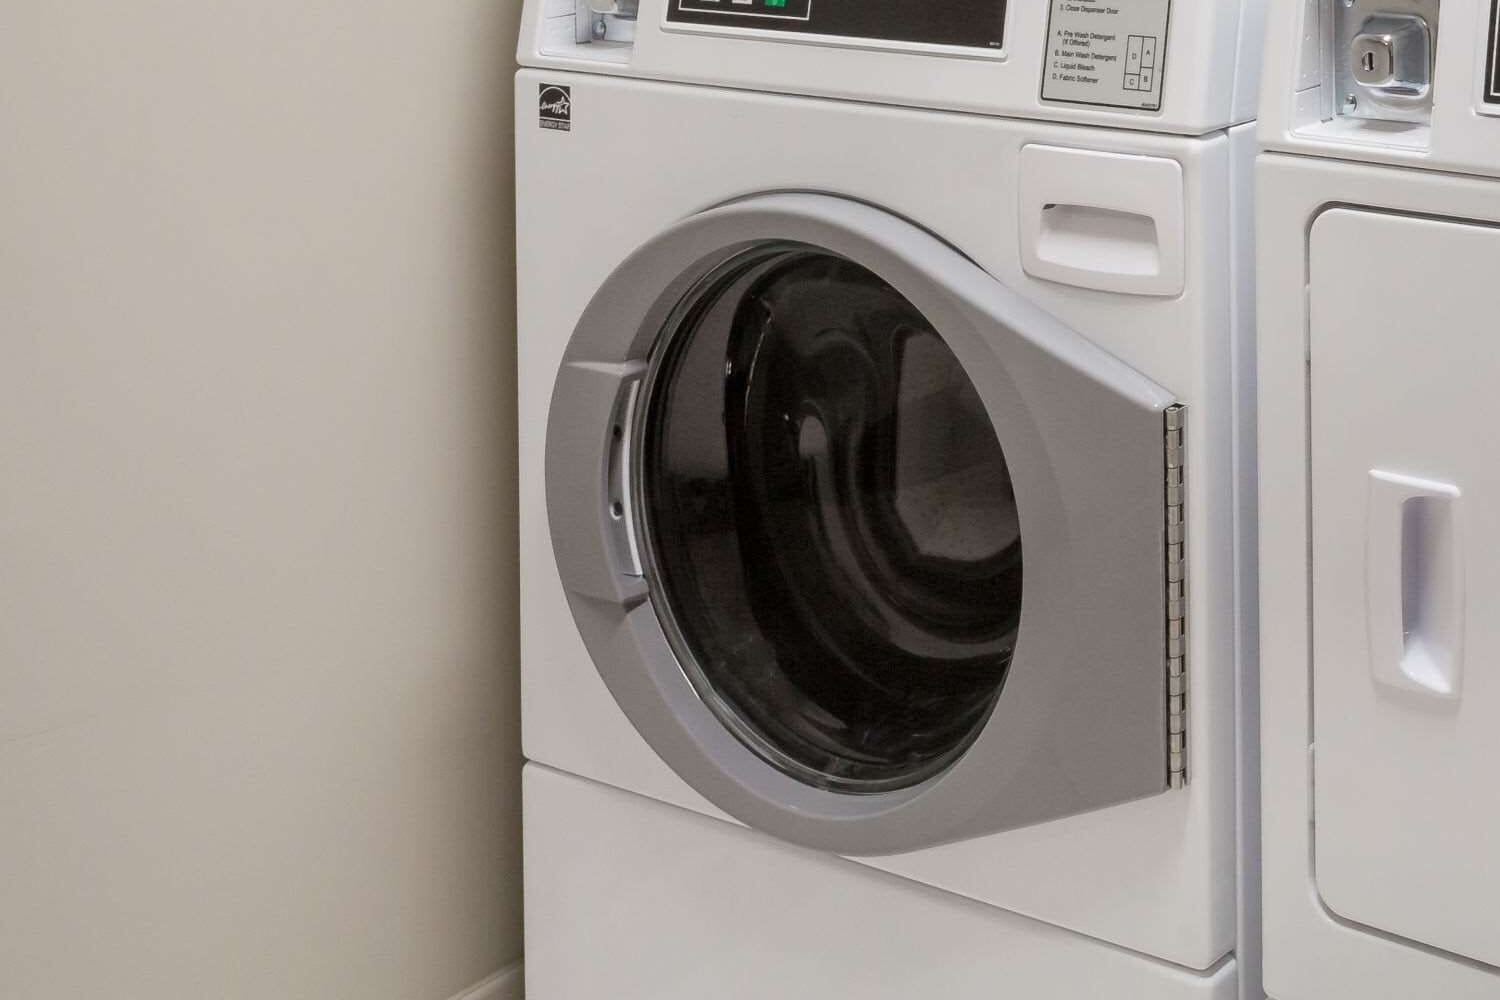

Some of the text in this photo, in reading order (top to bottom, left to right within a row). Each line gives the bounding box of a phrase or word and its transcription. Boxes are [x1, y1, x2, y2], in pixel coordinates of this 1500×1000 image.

[1090, 33, 1115, 42] Detergent
[1070, 39, 1090, 48] Offered)
[1092, 53, 1116, 61] Detergent
[1077, 75, 1099, 83] Softener
